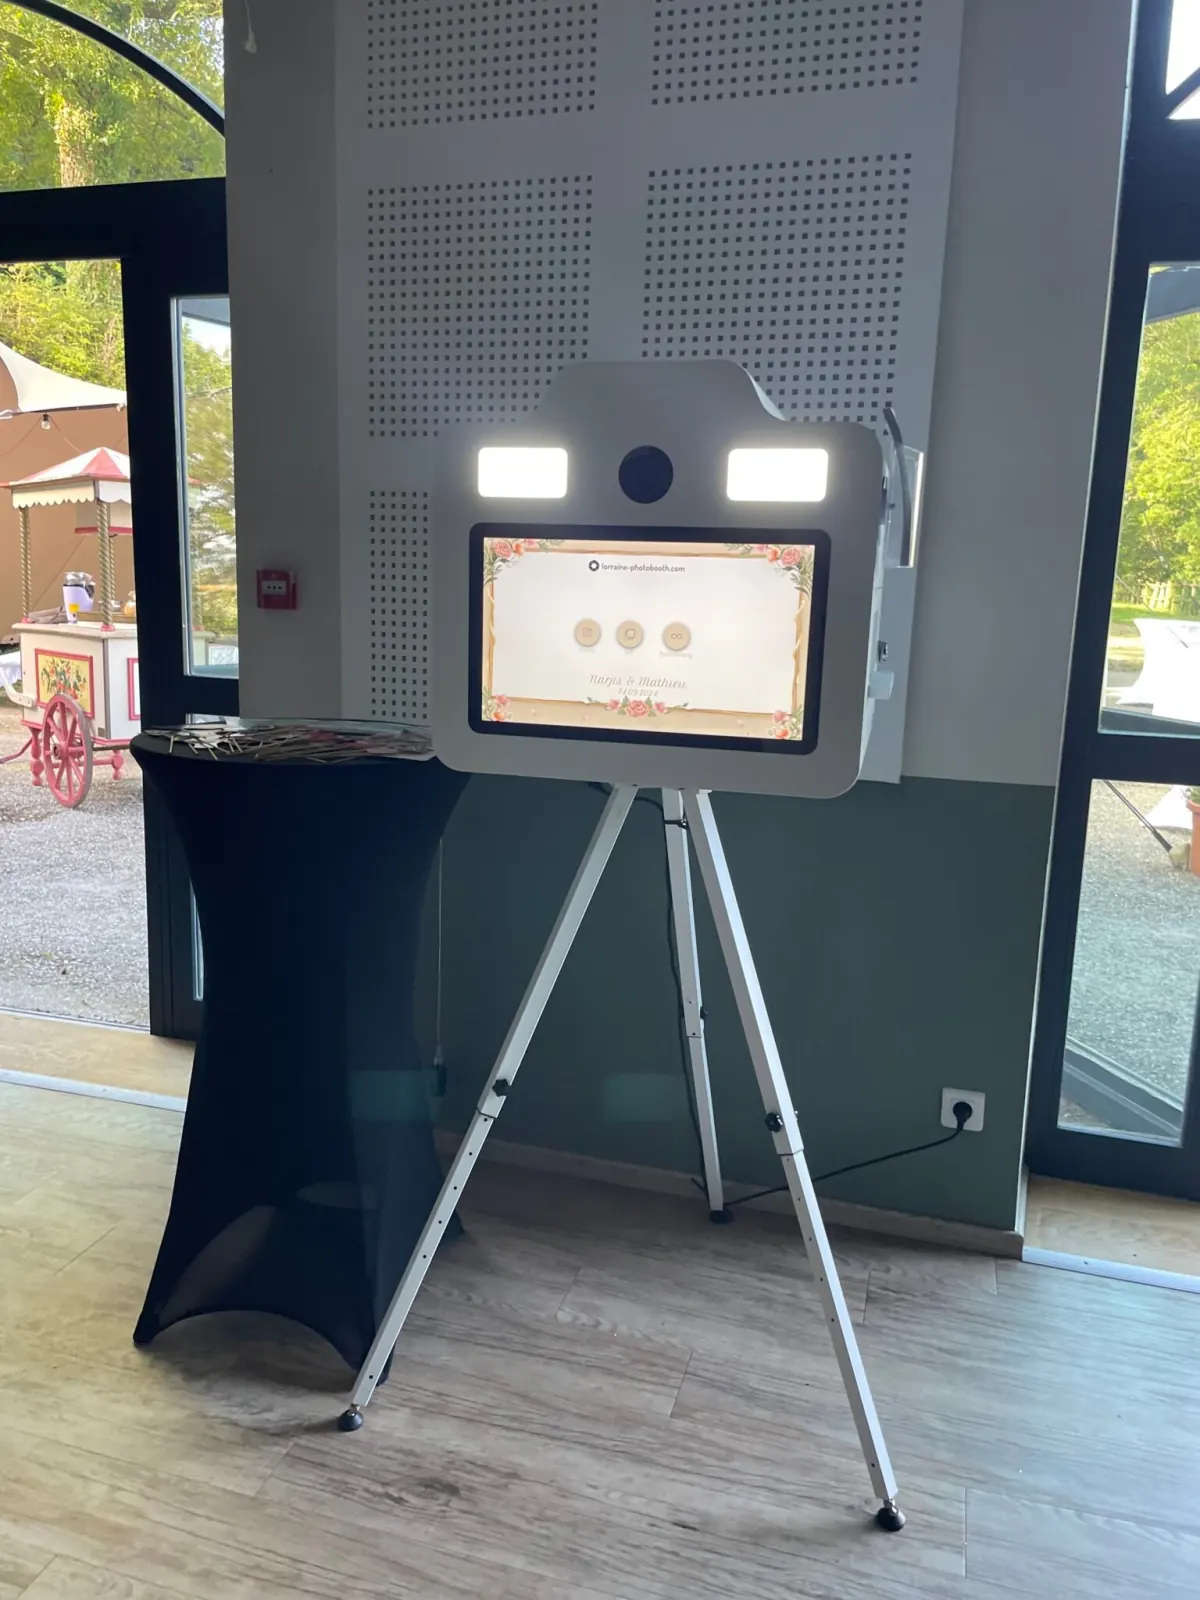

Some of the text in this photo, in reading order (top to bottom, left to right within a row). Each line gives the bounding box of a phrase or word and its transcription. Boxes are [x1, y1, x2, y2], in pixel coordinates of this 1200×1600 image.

[601, 563, 686, 573] lorraine-photobooth.com
[627, 676, 635, 686] &
[638, 676, 688, 689] Mathieu
